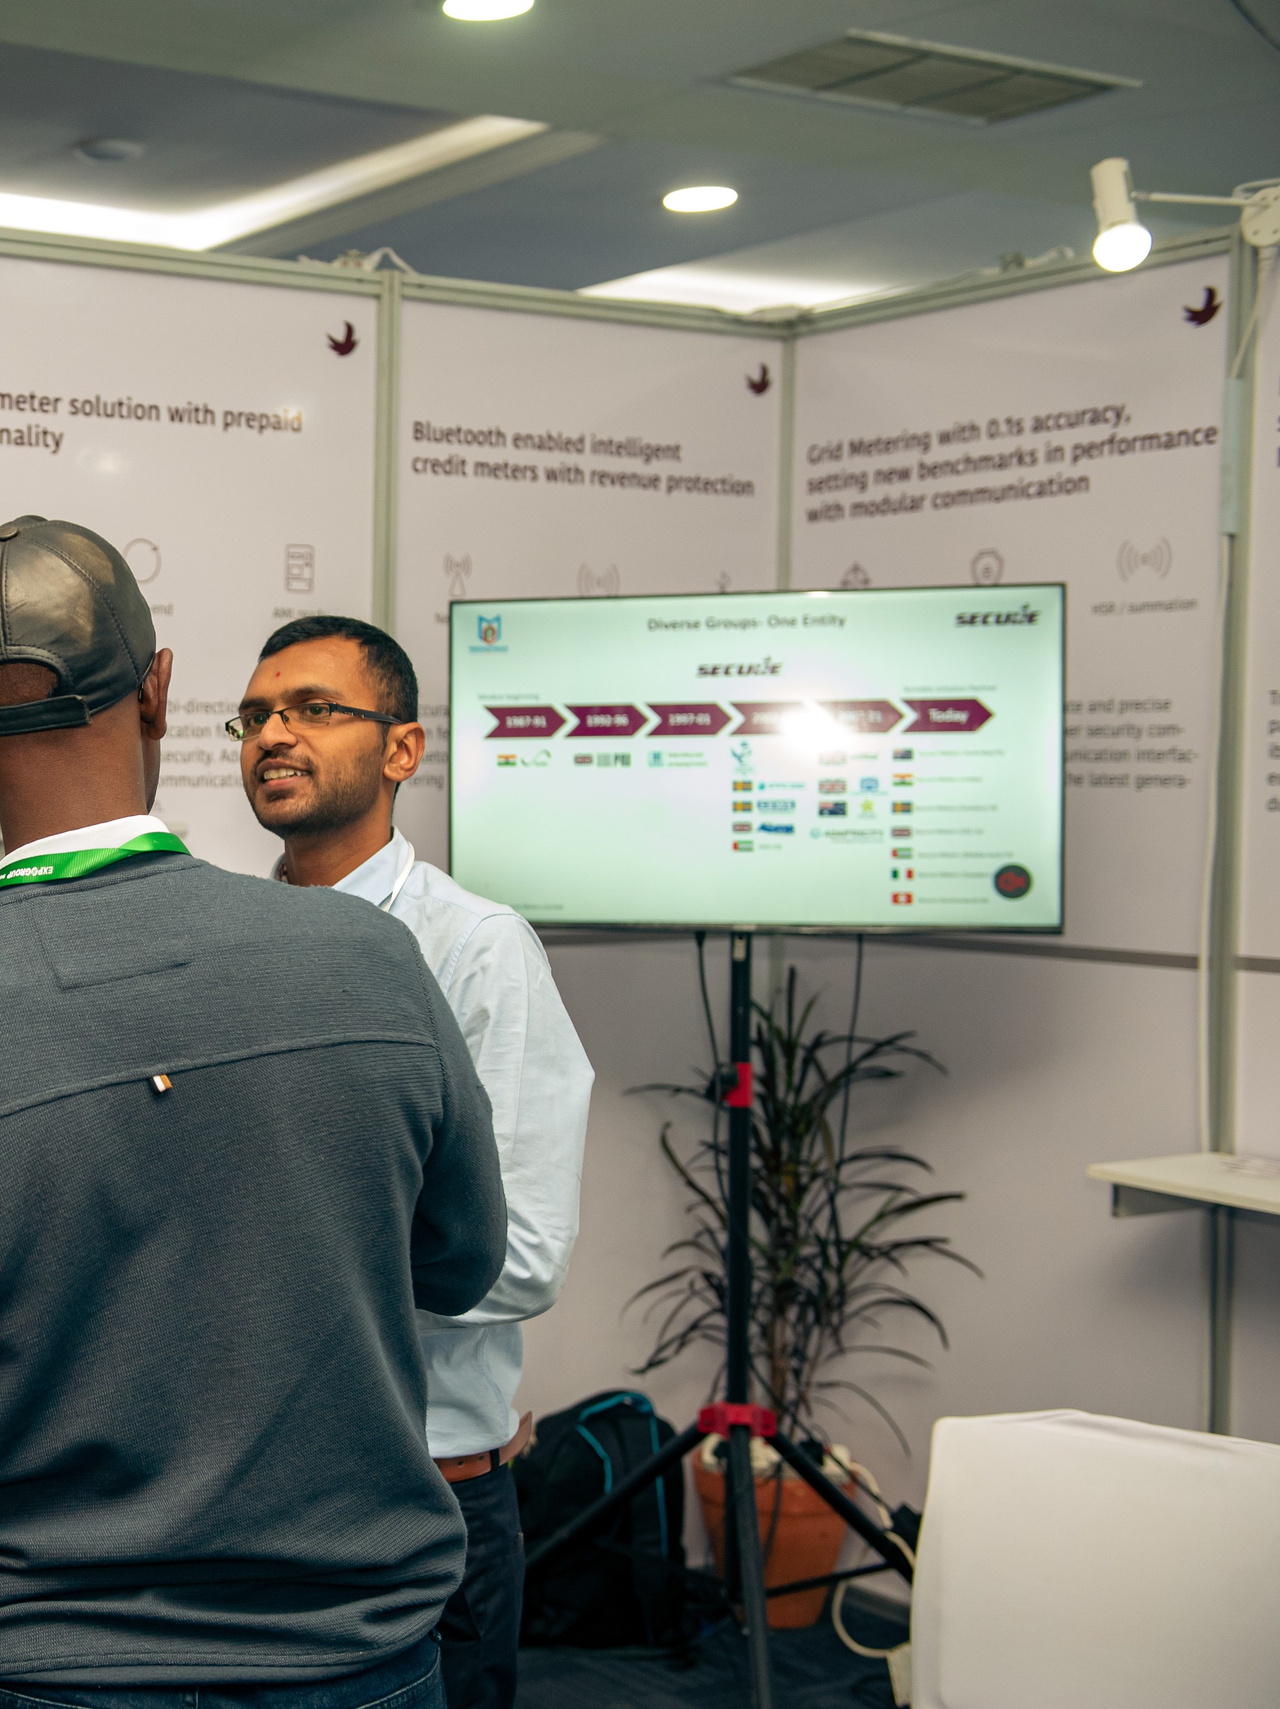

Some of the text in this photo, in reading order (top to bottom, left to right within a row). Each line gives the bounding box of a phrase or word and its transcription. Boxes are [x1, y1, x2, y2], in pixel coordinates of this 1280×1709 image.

[69, 395, 161, 422] solution
[167, 401, 216, 427] with
[223, 407, 303, 436] prepaid
[807, 440, 843, 466] Grid
[849, 429, 932, 459] Metering
[937, 421, 981, 446] with
[1031, 403, 1132, 434] accuracy,
[413, 421, 681, 464] Bluetooth enabled intelligent
[807, 423, 1218, 496] setting new benchmarks in performance
[412, 454, 754, 497] credit meters with revenue protection
[807, 473, 1090, 523] with modular communication
[648, 618, 701, 632] Diverse
[767, 614, 797, 628] One
[802, 613, 846, 629] Entity
[928, 707, 970, 726] Today
